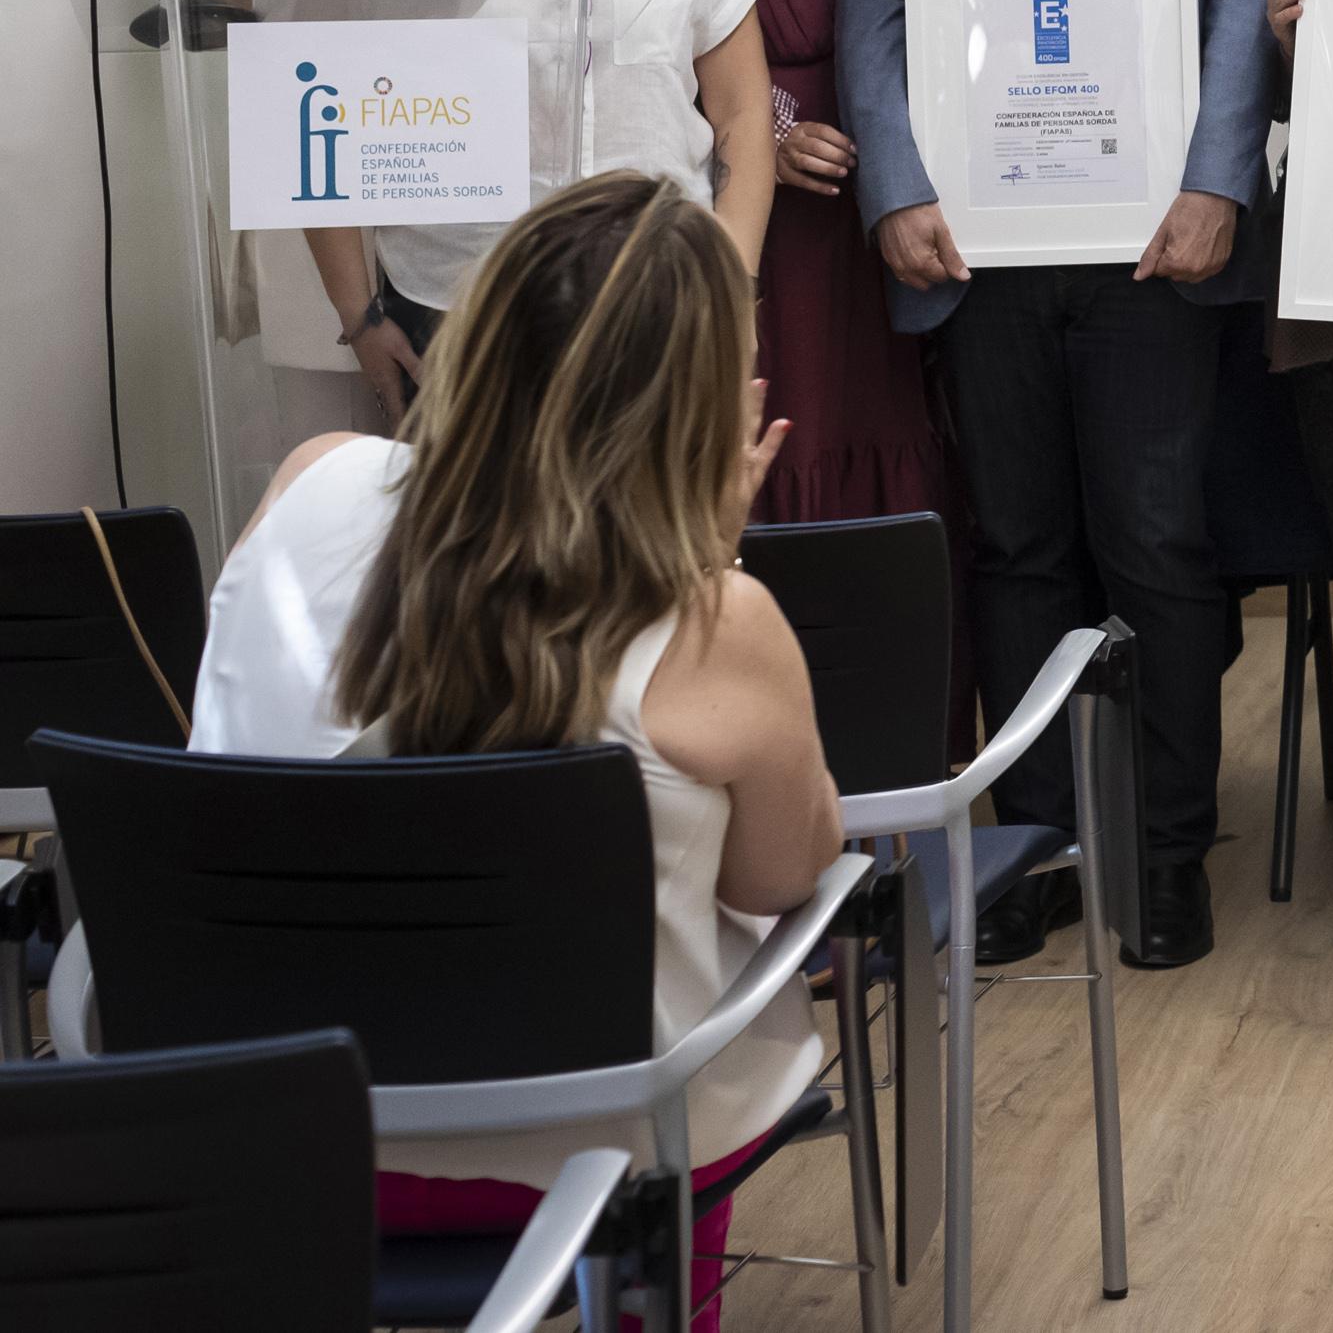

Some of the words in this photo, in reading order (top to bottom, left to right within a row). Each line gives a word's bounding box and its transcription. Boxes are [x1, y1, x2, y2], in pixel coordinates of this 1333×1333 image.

[1038, 54, 1053, 62] 400
[1008, 86, 1041, 96] SELLO
[1045, 85, 1077, 94] EFQM
[1080, 85, 1100, 93] 400
[361, 97, 471, 127] FIAPAS
[996, 111, 1061, 119] CONFEDERACIÓN
[1063, 109, 1103, 117] ESPAÑOLA
[995, 120, 1029, 128] FAMILIAS
[1041, 128, 1072, 136] (FIAPAS)
[361, 140, 466, 154] CONFEDERACIÓN
[362, 156, 426, 170] ESPAÑOLA
[362, 174, 377, 184] DE
[382, 172, 439, 184] FAMILIAS
[362, 189, 378, 200] DE
[382, 187, 449, 199] PERSONAS
[453, 186, 503, 197] SORDAS
